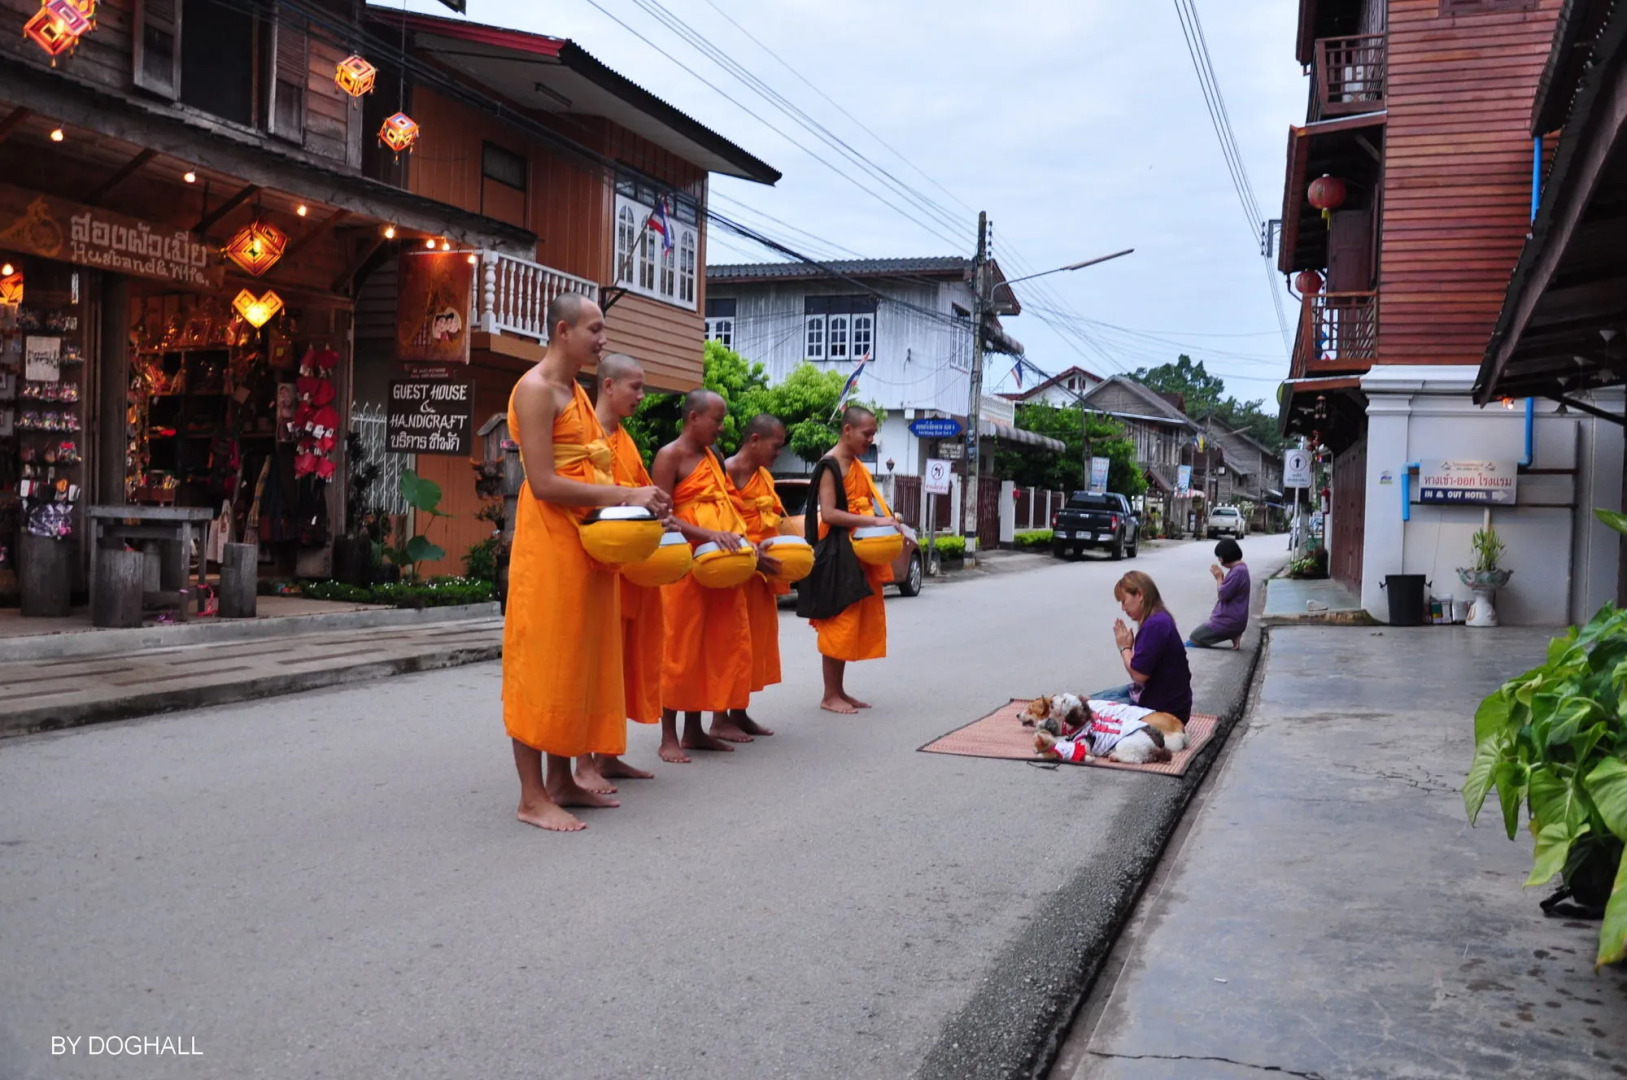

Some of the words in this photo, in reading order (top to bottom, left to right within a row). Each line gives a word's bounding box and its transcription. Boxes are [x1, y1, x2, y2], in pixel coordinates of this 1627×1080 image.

[70, 212, 207, 267] สองผัวเมีย
[392, 383, 430, 400] GUEST
[430, 384, 468, 401] HOUSE
[419, 399, 437, 414] &
[389, 414, 468, 430] HANDICRAFT
[1478, 472, 1512, 488] โรงแรม
[1424, 490, 1433, 499] IN
[1435, 490, 1444, 499] &
[1447, 490, 1463, 499] OUT
[1464, 490, 1487, 500] HOTEL
